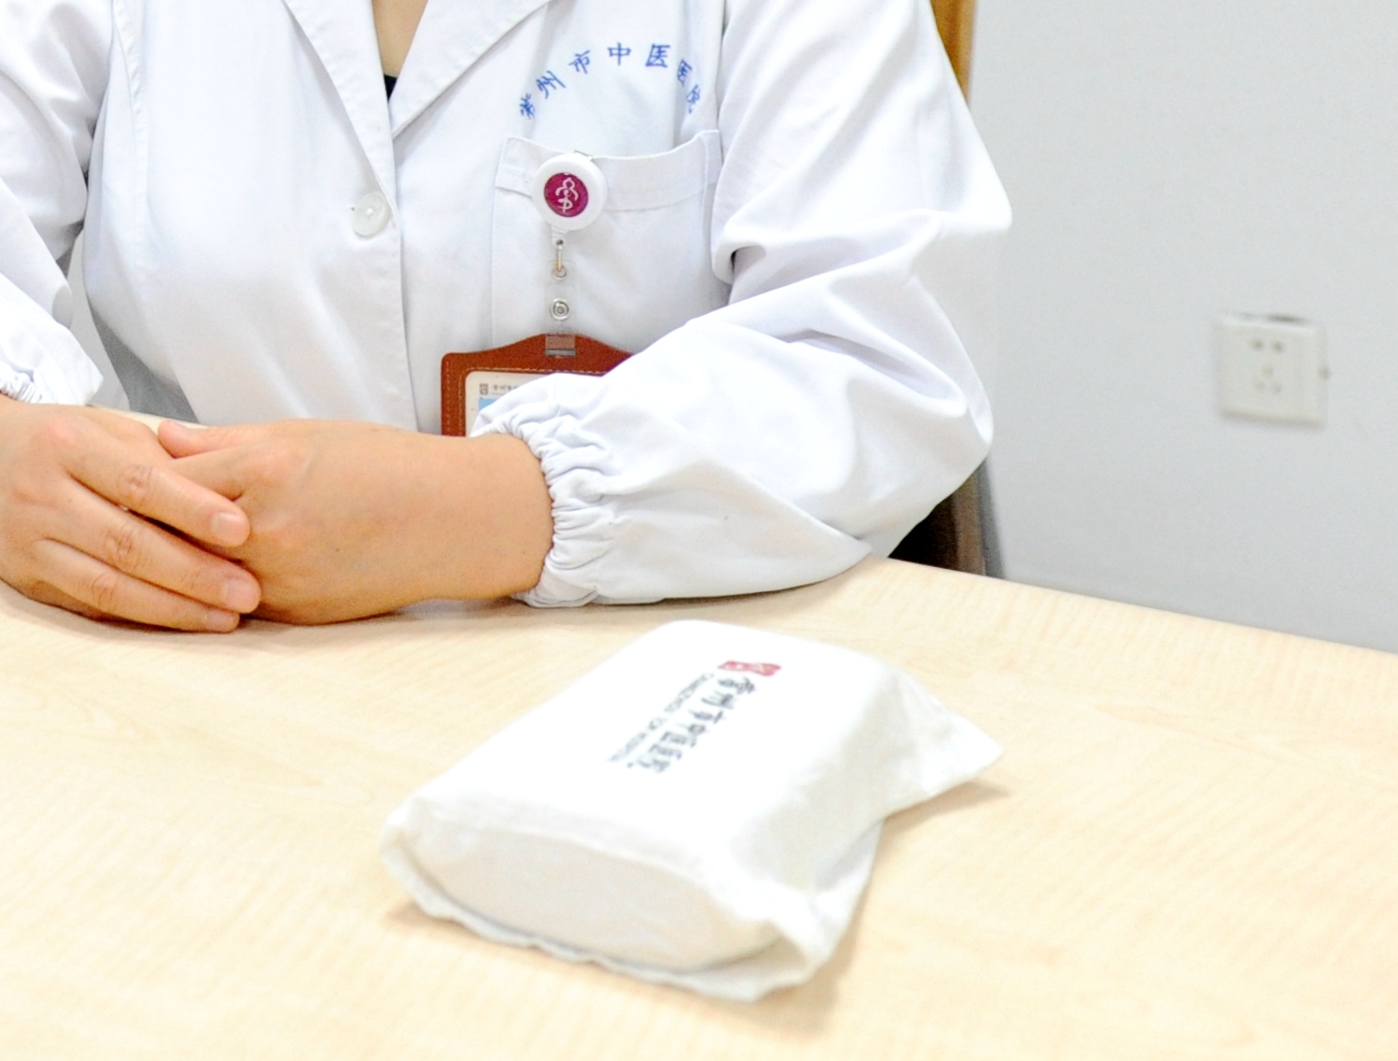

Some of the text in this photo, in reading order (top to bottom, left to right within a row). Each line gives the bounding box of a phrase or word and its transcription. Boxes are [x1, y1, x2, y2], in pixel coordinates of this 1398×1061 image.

[519, 41, 702, 120] 常州市中医医院
